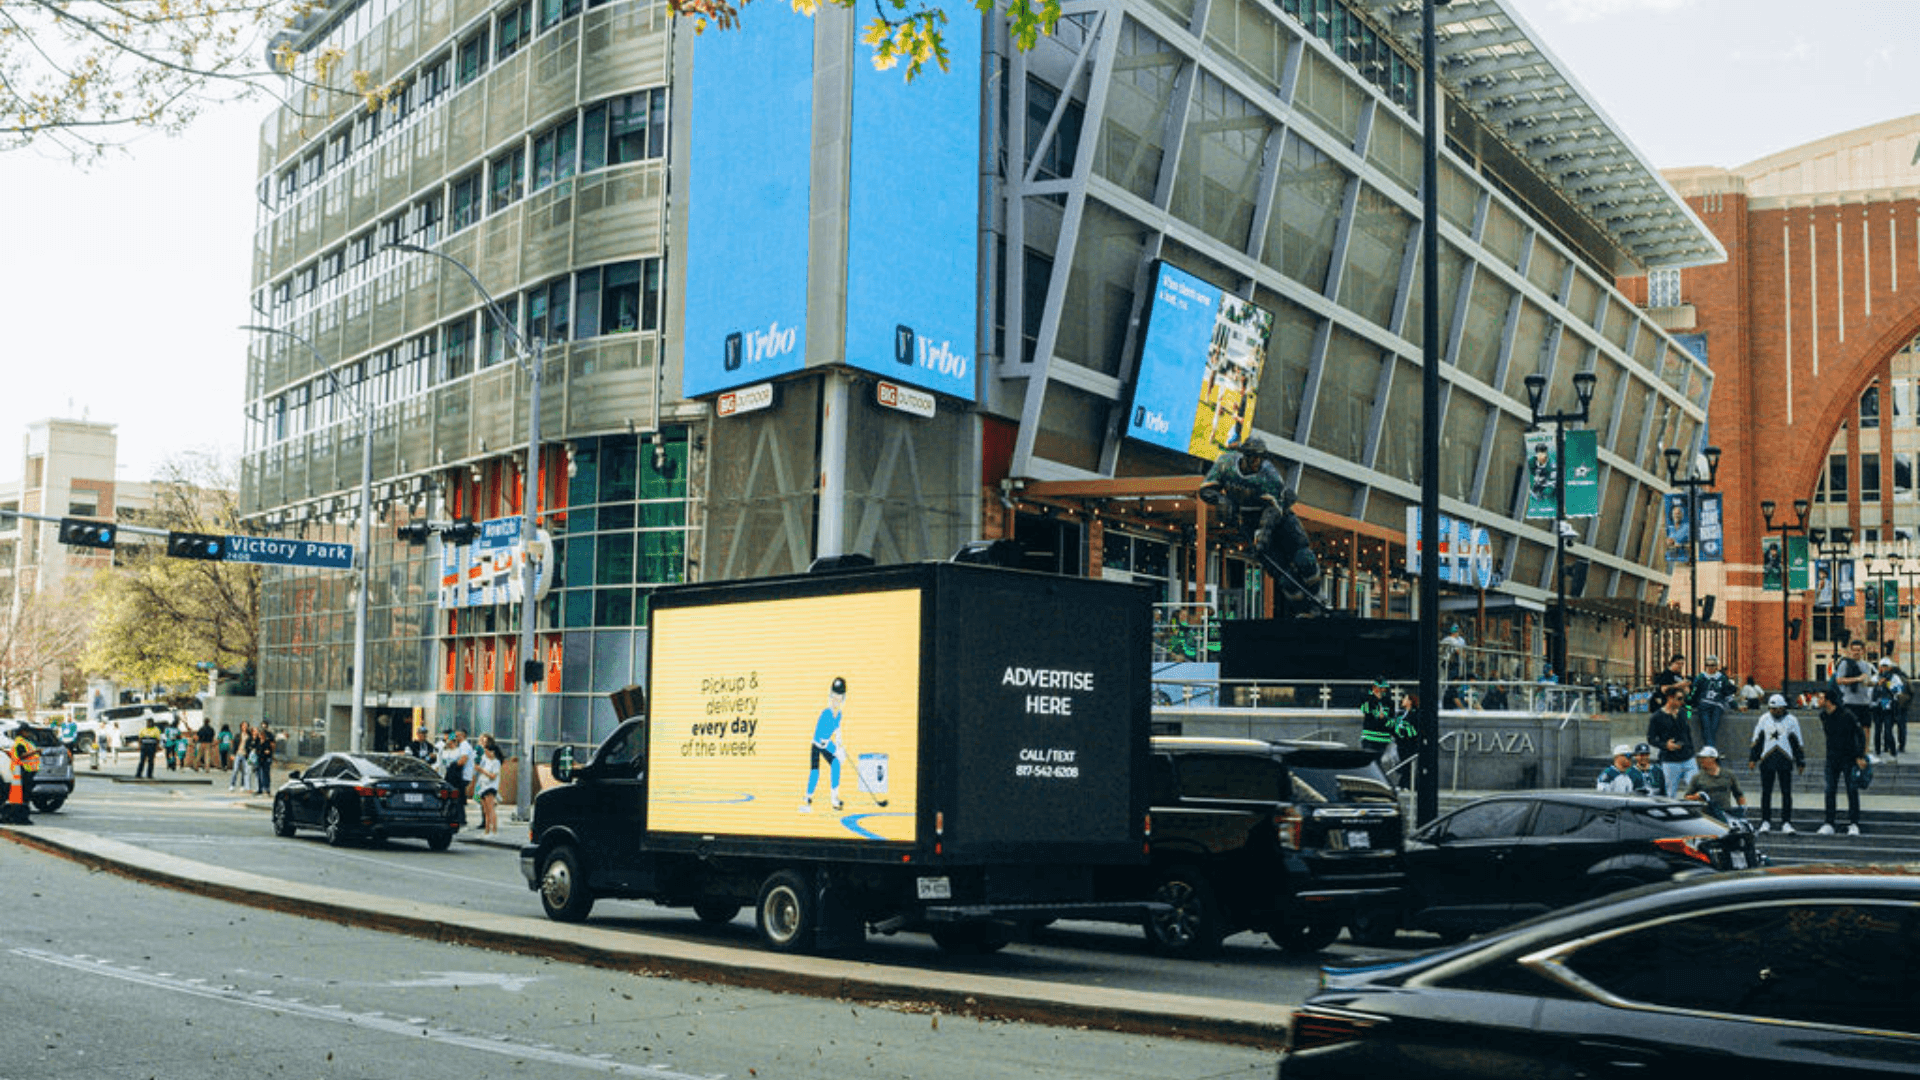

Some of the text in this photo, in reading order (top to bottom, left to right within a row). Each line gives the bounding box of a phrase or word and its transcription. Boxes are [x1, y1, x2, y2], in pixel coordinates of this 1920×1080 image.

[746, 321, 796, 363] Vrbo
[917, 335, 967, 378] Vrbo
[737, 388, 770, 406] OUTDOOR
[881, 386, 932, 411] BIG OUTDOOR
[231, 538, 347, 560] Victory Park
[1406, 506, 1492, 589] ERO
[701, 671, 759, 695] Pickup &
[1002, 665, 1095, 691] ADVERTISE
[706, 696, 758, 715] delivery
[1026, 694, 1072, 716] HERE
[691, 717, 758, 738] every day
[681, 737, 757, 757] of the week
[1464, 730, 1535, 754] PLAZA
